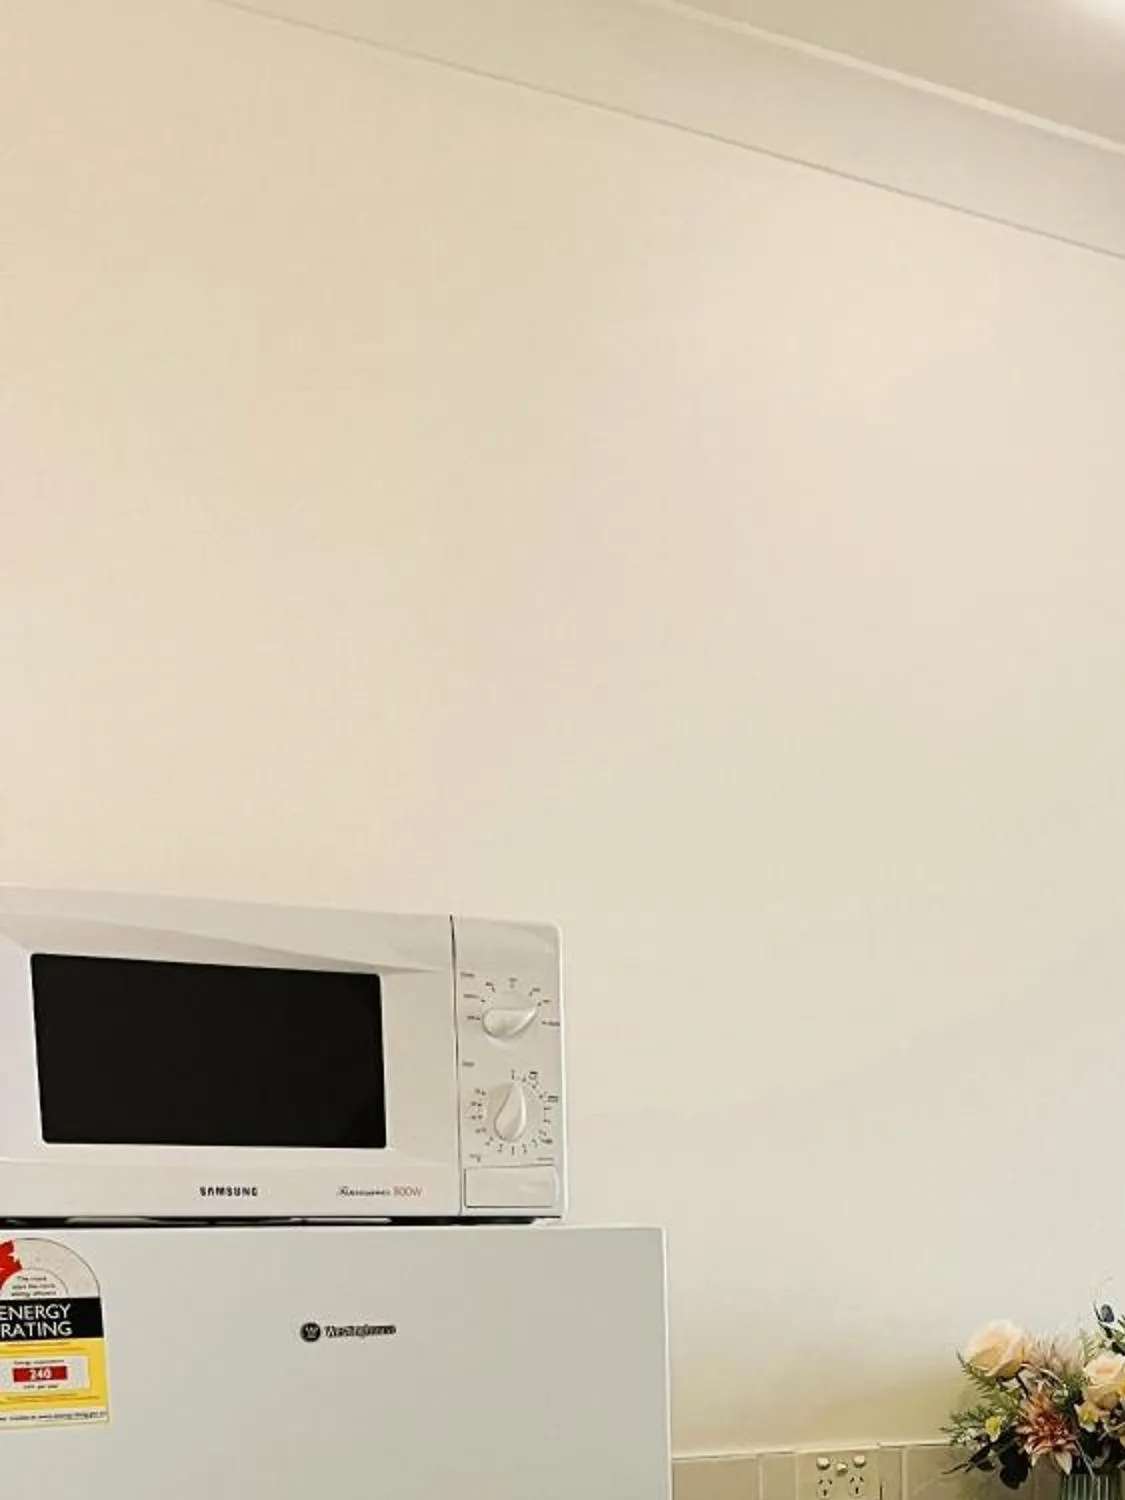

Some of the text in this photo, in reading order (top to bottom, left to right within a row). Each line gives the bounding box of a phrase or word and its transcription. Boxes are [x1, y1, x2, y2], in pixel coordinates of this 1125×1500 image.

[199, 1186, 259, 1197] SAMSUNG
[0, 1303, 71, 1321] ENERGY
[1, 1320, 73, 1339] RATING
